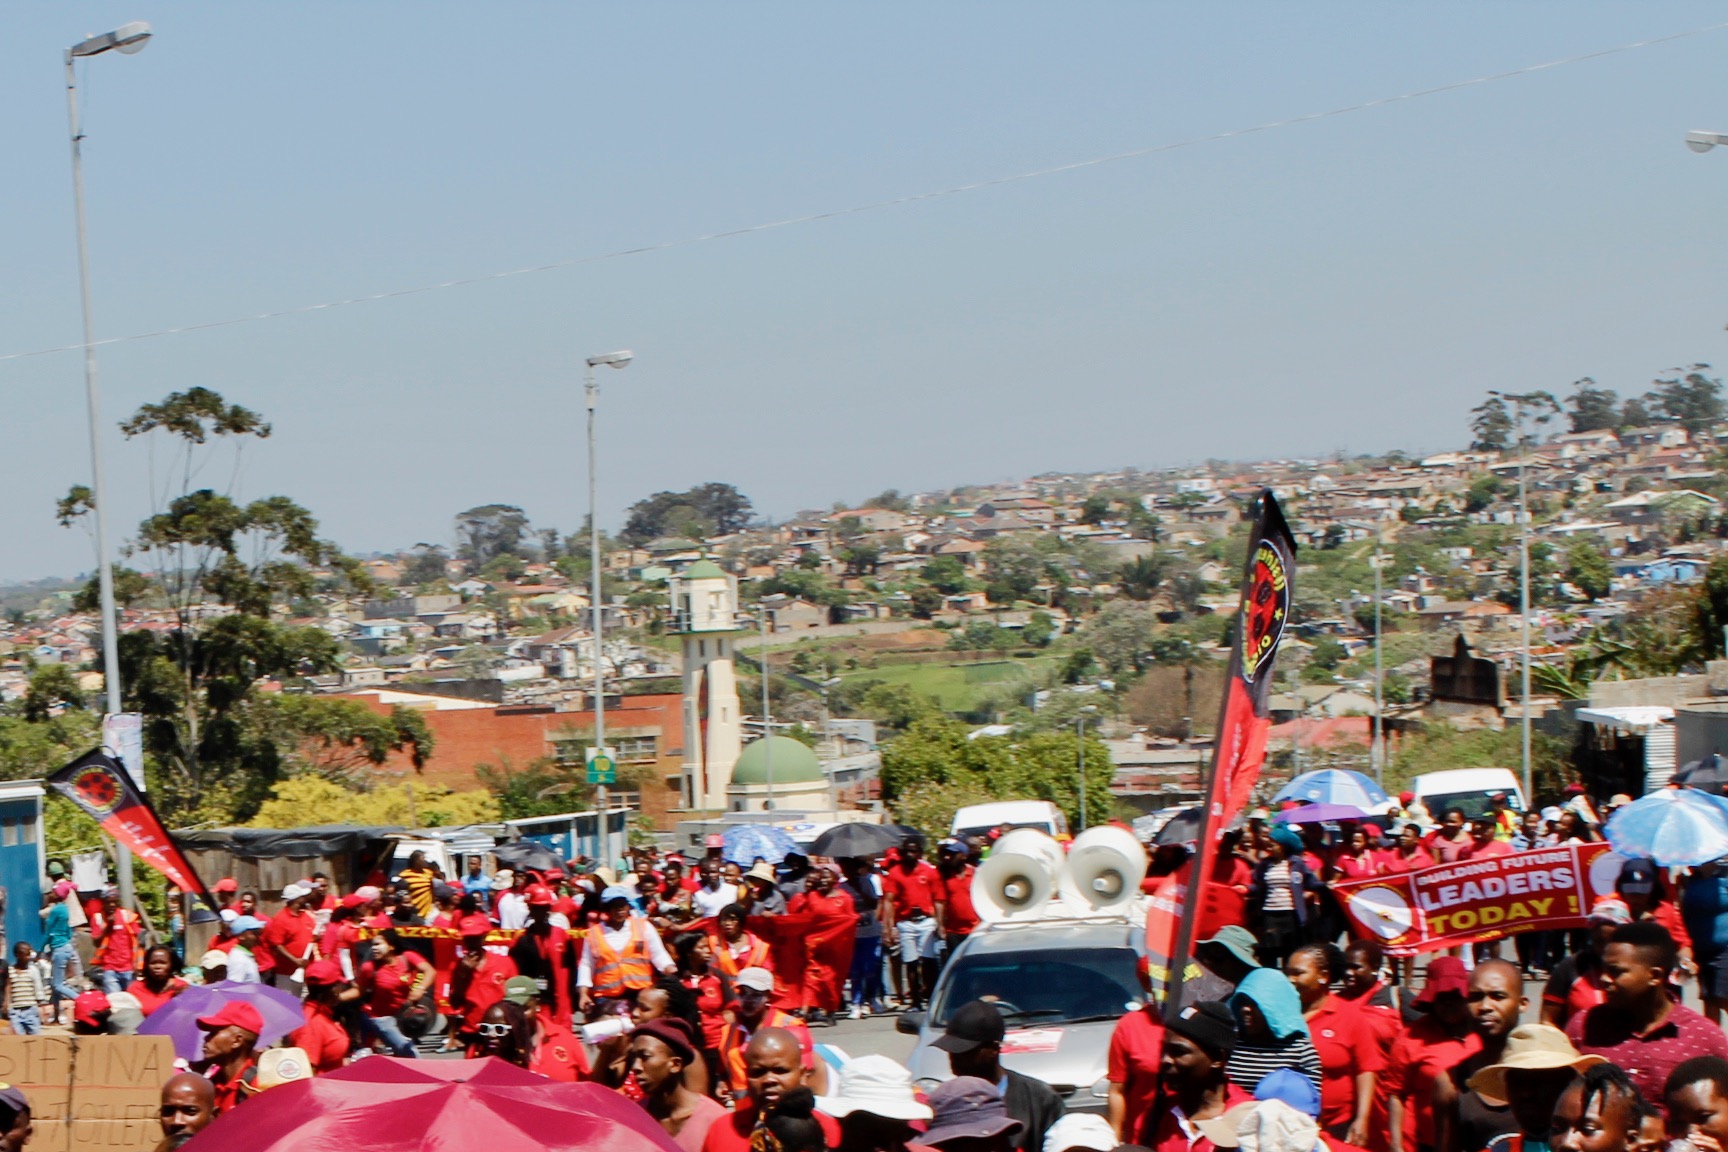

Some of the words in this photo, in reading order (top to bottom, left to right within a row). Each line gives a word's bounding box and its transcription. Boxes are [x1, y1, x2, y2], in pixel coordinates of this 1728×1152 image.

[1418, 860, 1499, 887] BUILDING
[1502, 850, 1571, 870] FUTURE
[1420, 867, 1575, 911] LEADERS
[1429, 897, 1555, 934] TODAY
